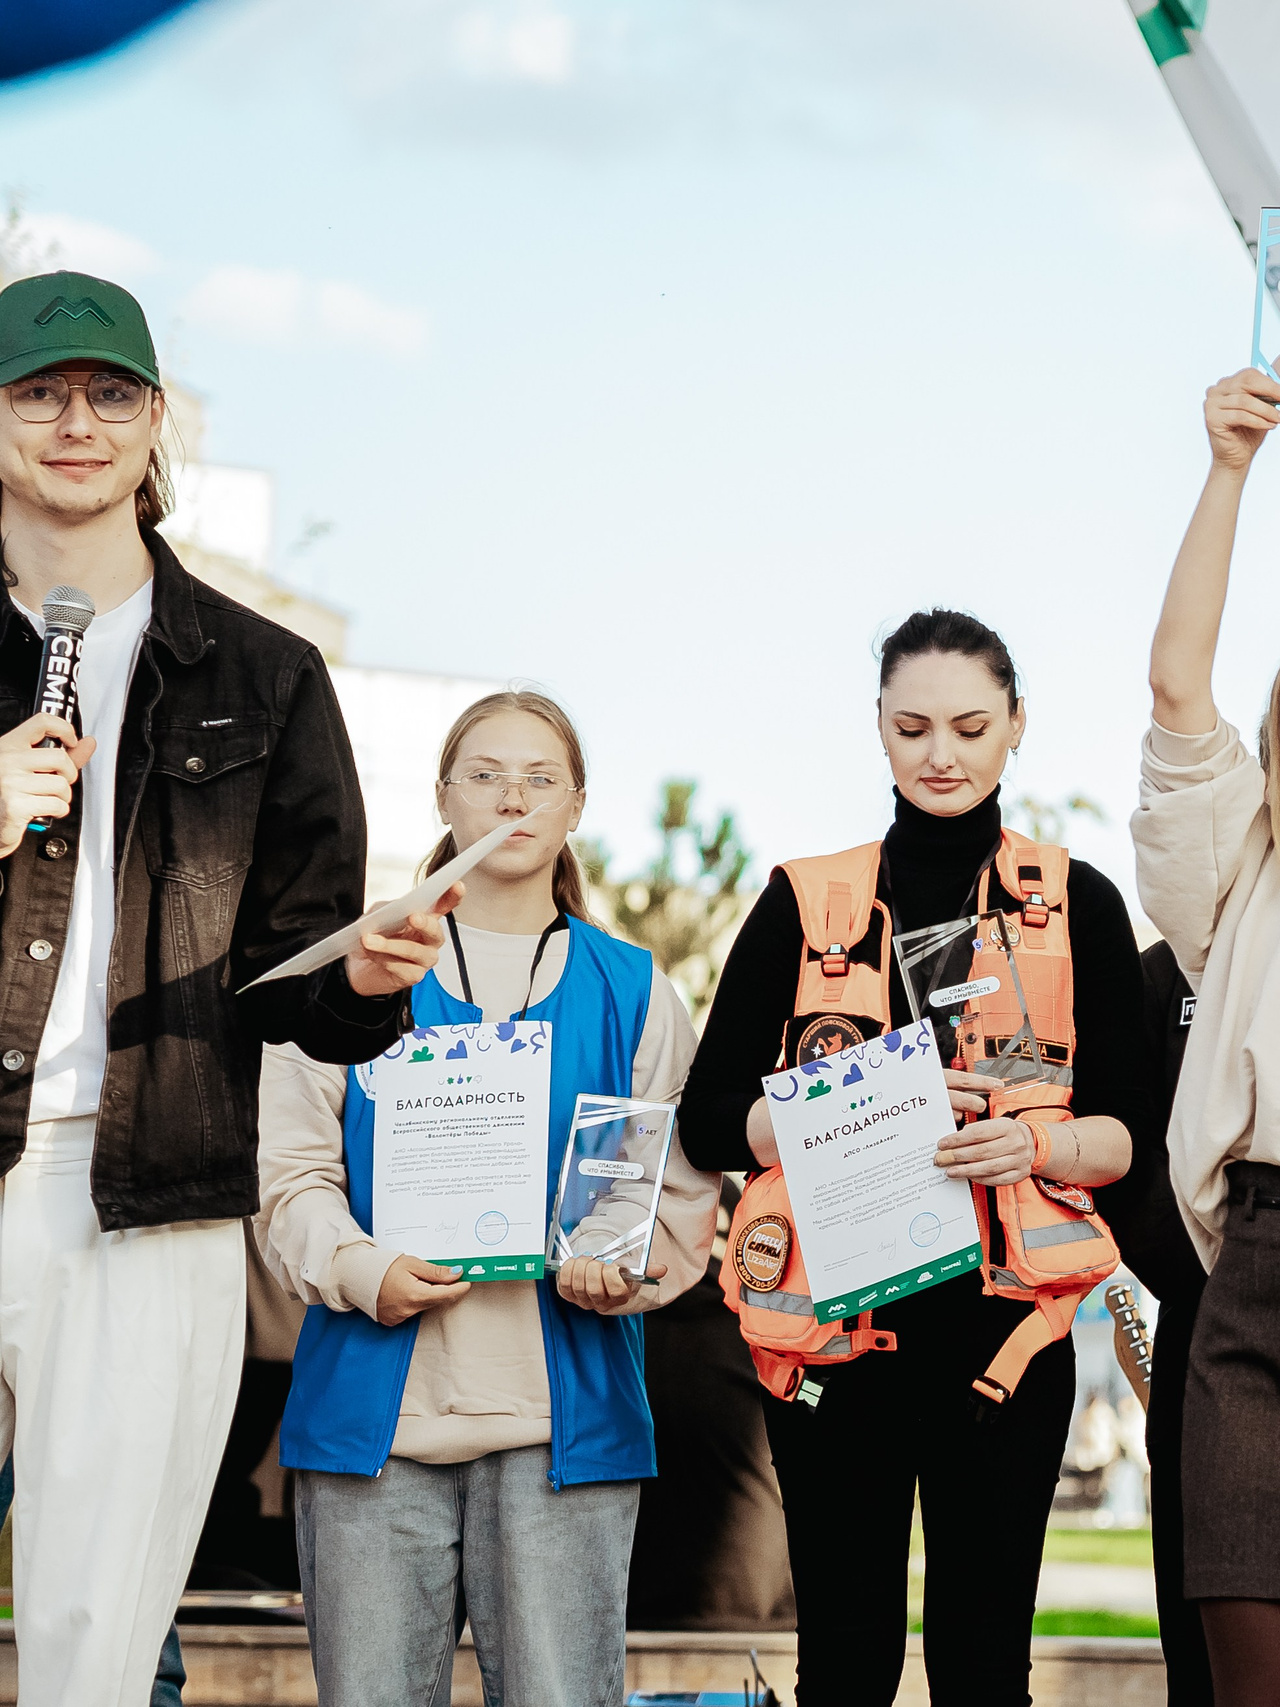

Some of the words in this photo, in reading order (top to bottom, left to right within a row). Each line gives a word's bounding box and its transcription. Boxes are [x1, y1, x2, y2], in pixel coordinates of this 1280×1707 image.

[949, 983, 979, 995] СПАСИБО,
[396, 1092, 525, 1110] БЛАГОДАРНОСТЬ
[803, 1095, 927, 1150] БЛАГОДАРНОСТЬ
